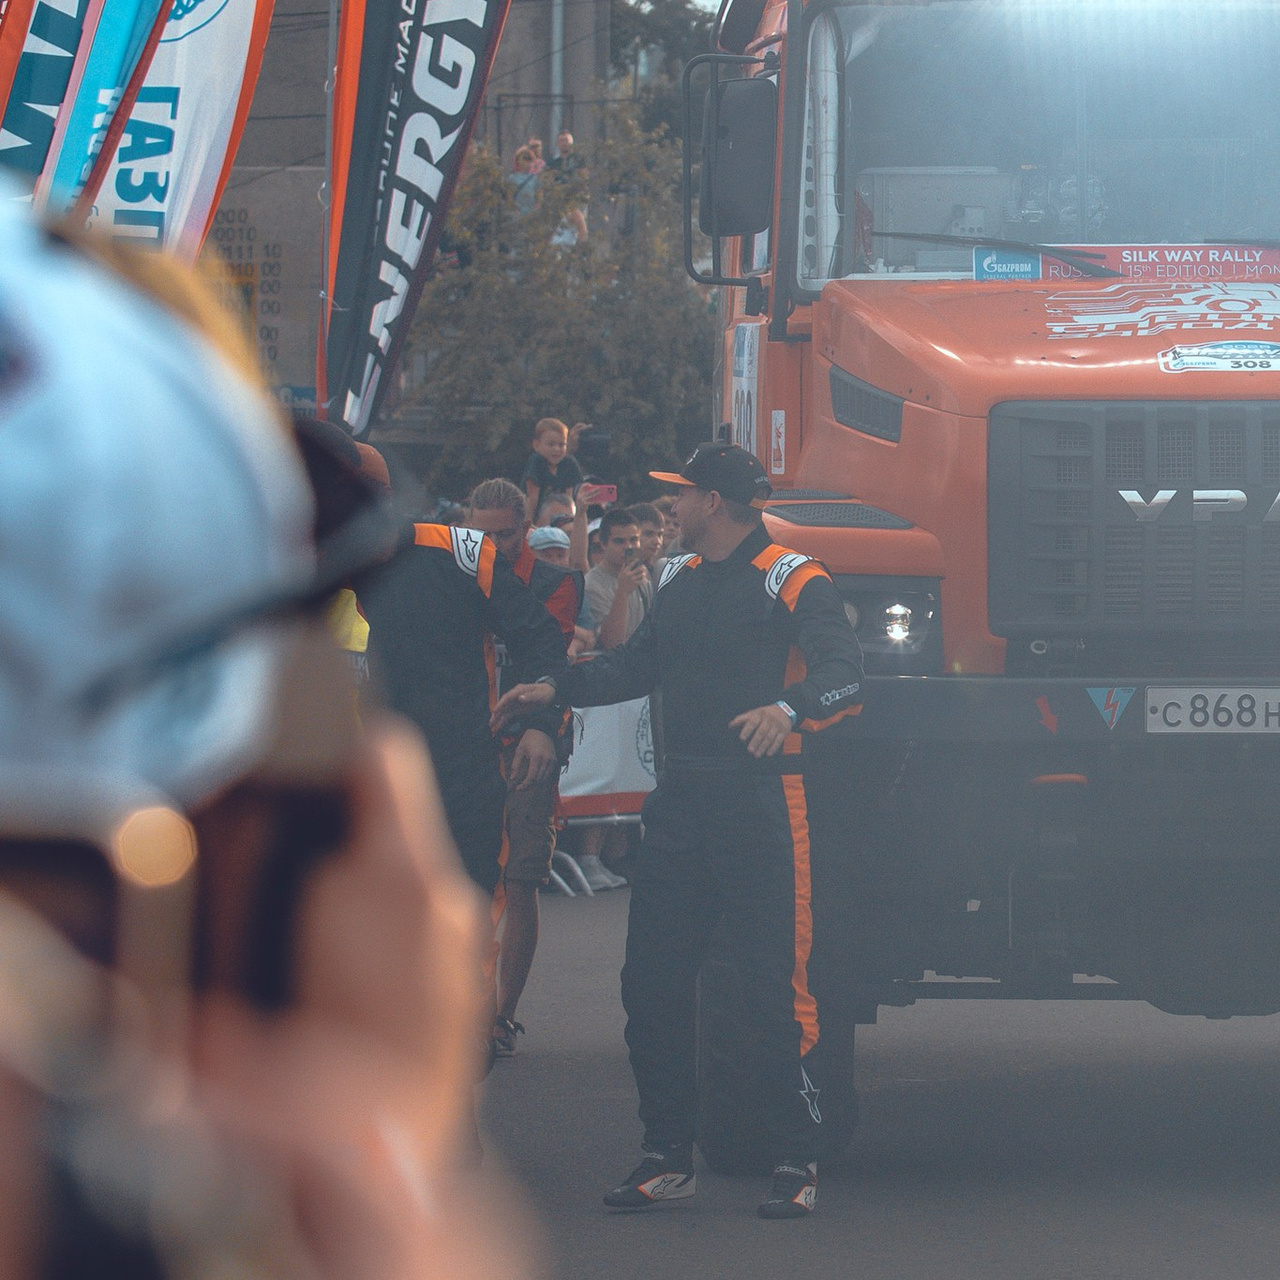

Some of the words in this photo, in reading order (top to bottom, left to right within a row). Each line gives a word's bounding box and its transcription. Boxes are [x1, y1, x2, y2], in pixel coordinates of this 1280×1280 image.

[1121, 250, 1160, 263] SILK
[1164, 250, 1204, 263] WAY
[1208, 250, 1264, 263] RALLY
[1126, 264, 1151, 277] 15th
[1156, 264, 1223, 277] EDITION
[1230, 360, 1272, 369] 308
